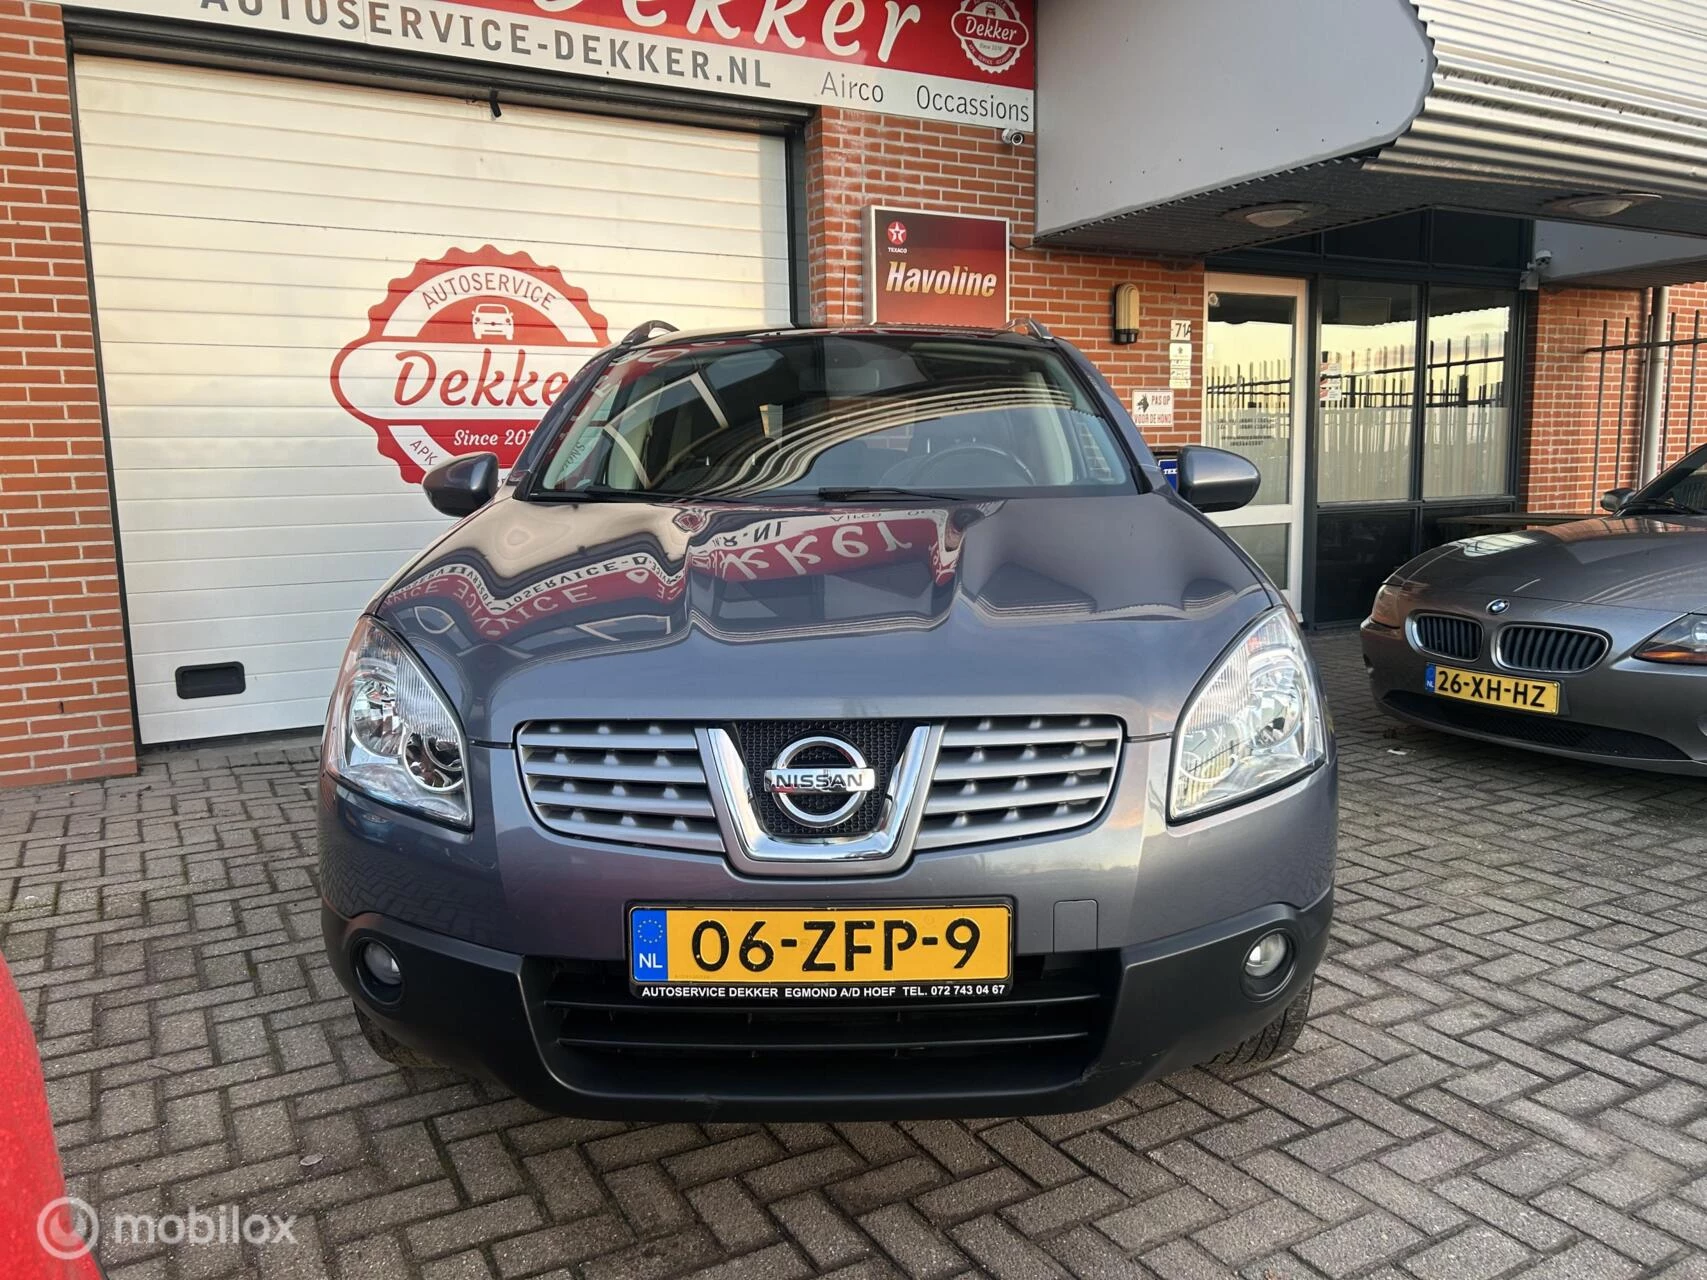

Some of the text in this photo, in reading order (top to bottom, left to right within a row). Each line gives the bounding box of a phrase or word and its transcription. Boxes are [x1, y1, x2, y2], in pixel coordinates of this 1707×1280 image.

[532, 0, 920, 63] ker
[965, 16, 1017, 41] Dekker
[821, 71, 1030, 123] Airco Occassions
[888, 246, 908, 254] TEXACO
[886, 261, 998, 298] Havoline
[421, 272, 557, 311] AUTOSERVICE
[1175, 322, 1192, 338] 71A
[1151, 395, 1171, 406] PAS OP
[453, 429, 499, 447] Since
[409, 440, 439, 466] APK
[1426, 680, 1434, 688] NL
[1438, 671, 1546, 708] 26-XH-HZ
[776, 774, 863, 788] NISSAN
[691, 917, 982, 972] 06-ZFP-9
[639, 953, 663, 969] NL
[642, 984, 1006, 998] AUTOSERVICE DEKKER EGMOND A/D HOEF TEL. 072 743 04 67
